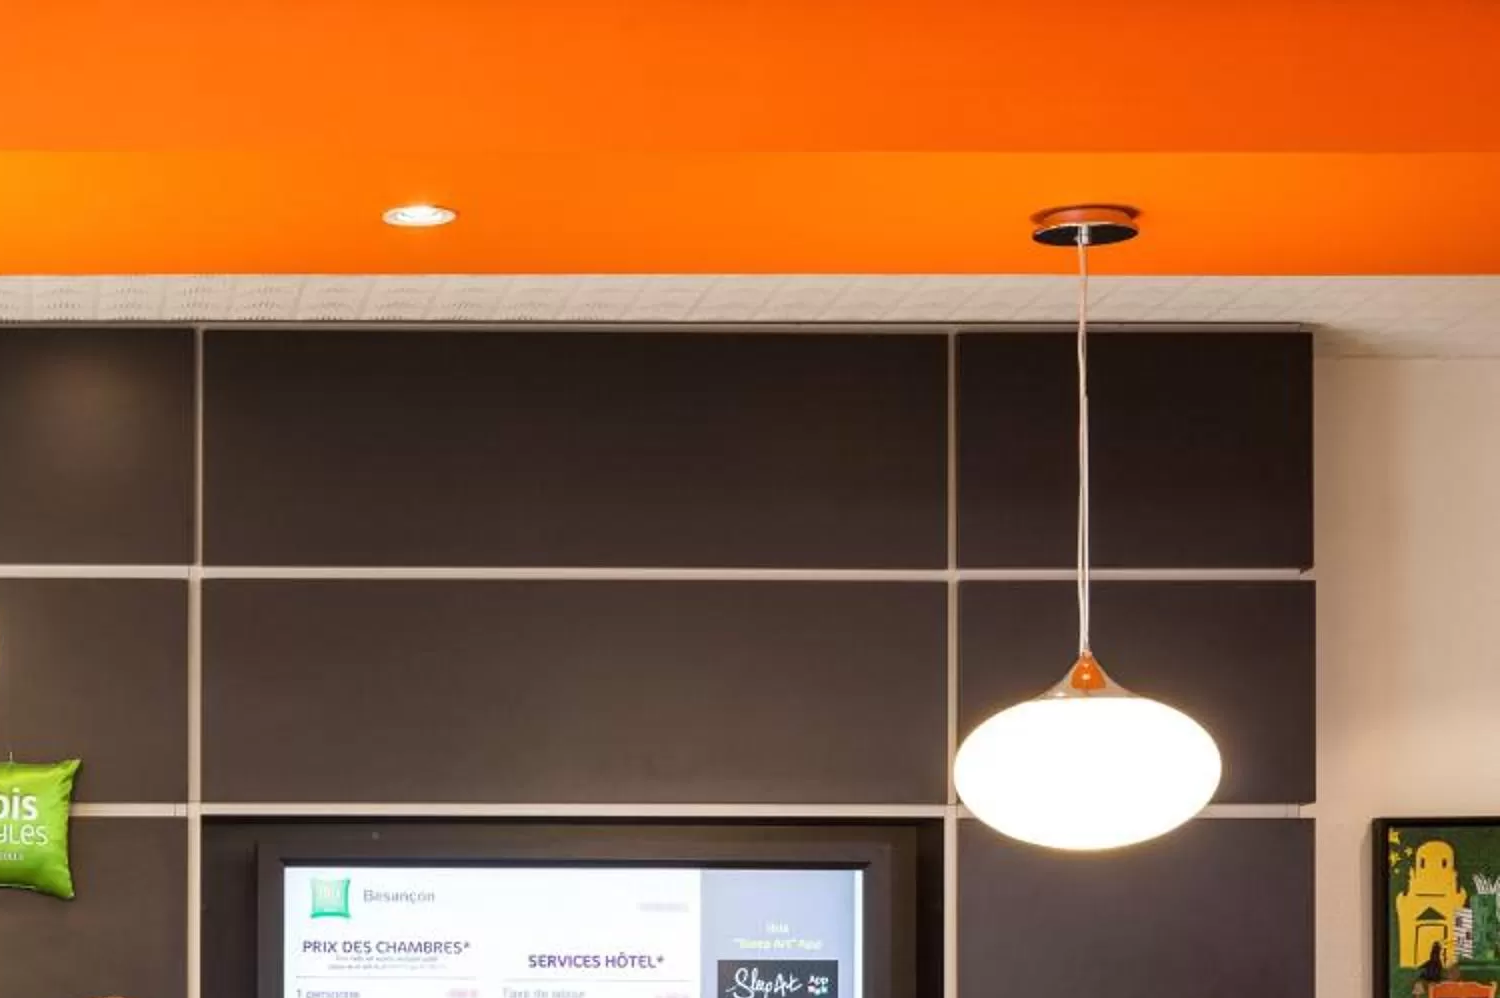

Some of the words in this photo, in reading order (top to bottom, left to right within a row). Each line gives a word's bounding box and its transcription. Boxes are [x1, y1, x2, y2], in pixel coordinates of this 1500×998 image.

[363, 889, 436, 905] Besançon
[302, 940, 338, 954] PRIX
[342, 940, 372, 954] DES
[528, 954, 601, 969] SERVICES
